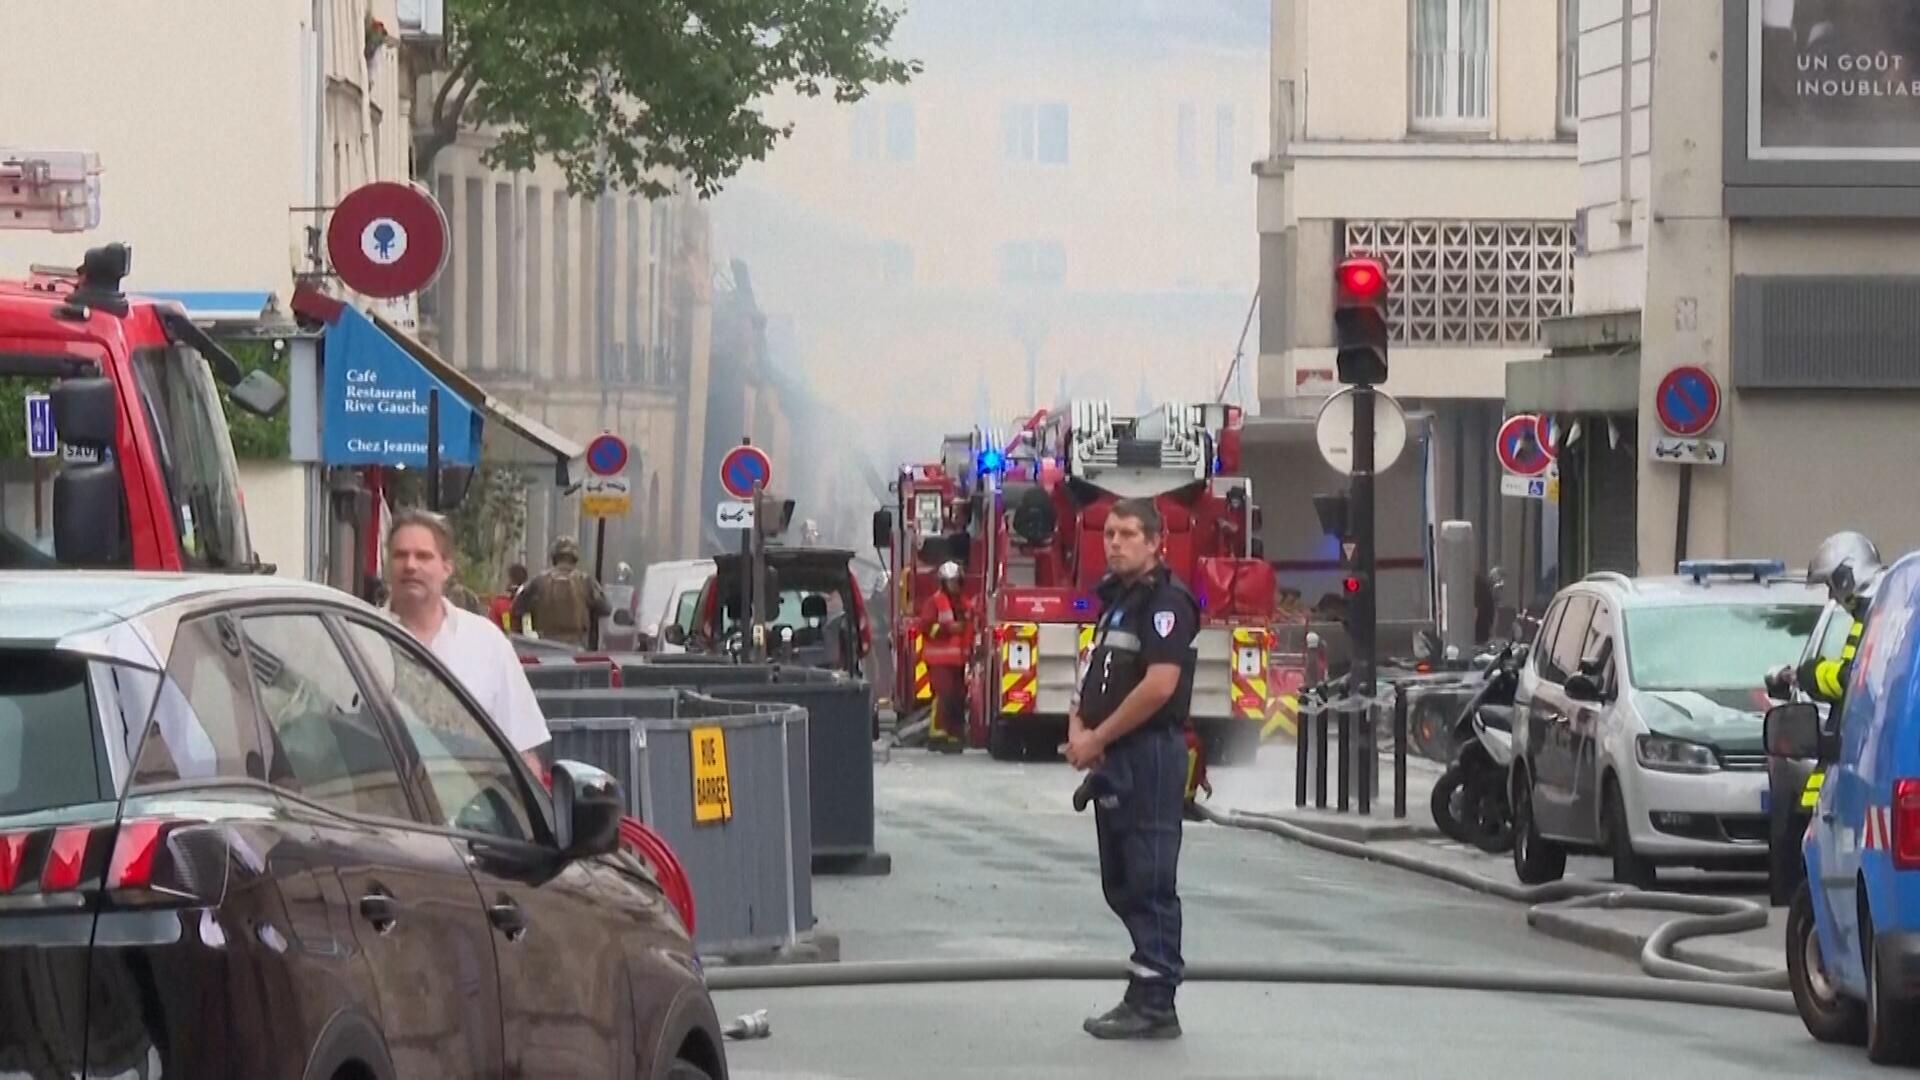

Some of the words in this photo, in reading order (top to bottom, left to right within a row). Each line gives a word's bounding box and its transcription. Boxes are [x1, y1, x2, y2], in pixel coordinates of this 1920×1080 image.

[1796, 54, 1829, 71] UN
[1837, 49, 1903, 71] GOÛT
[1796, 79, 1920, 97] INOUBLIAB
[346, 368, 378, 383] Café
[346, 385, 417, 401] Restaurant
[344, 399, 375, 413] Rive
[377, 400, 429, 415] Gauche
[346, 438, 380, 452] Chez
[383, 439, 446, 455] Jeannee
[701, 737, 717, 767] RUE
